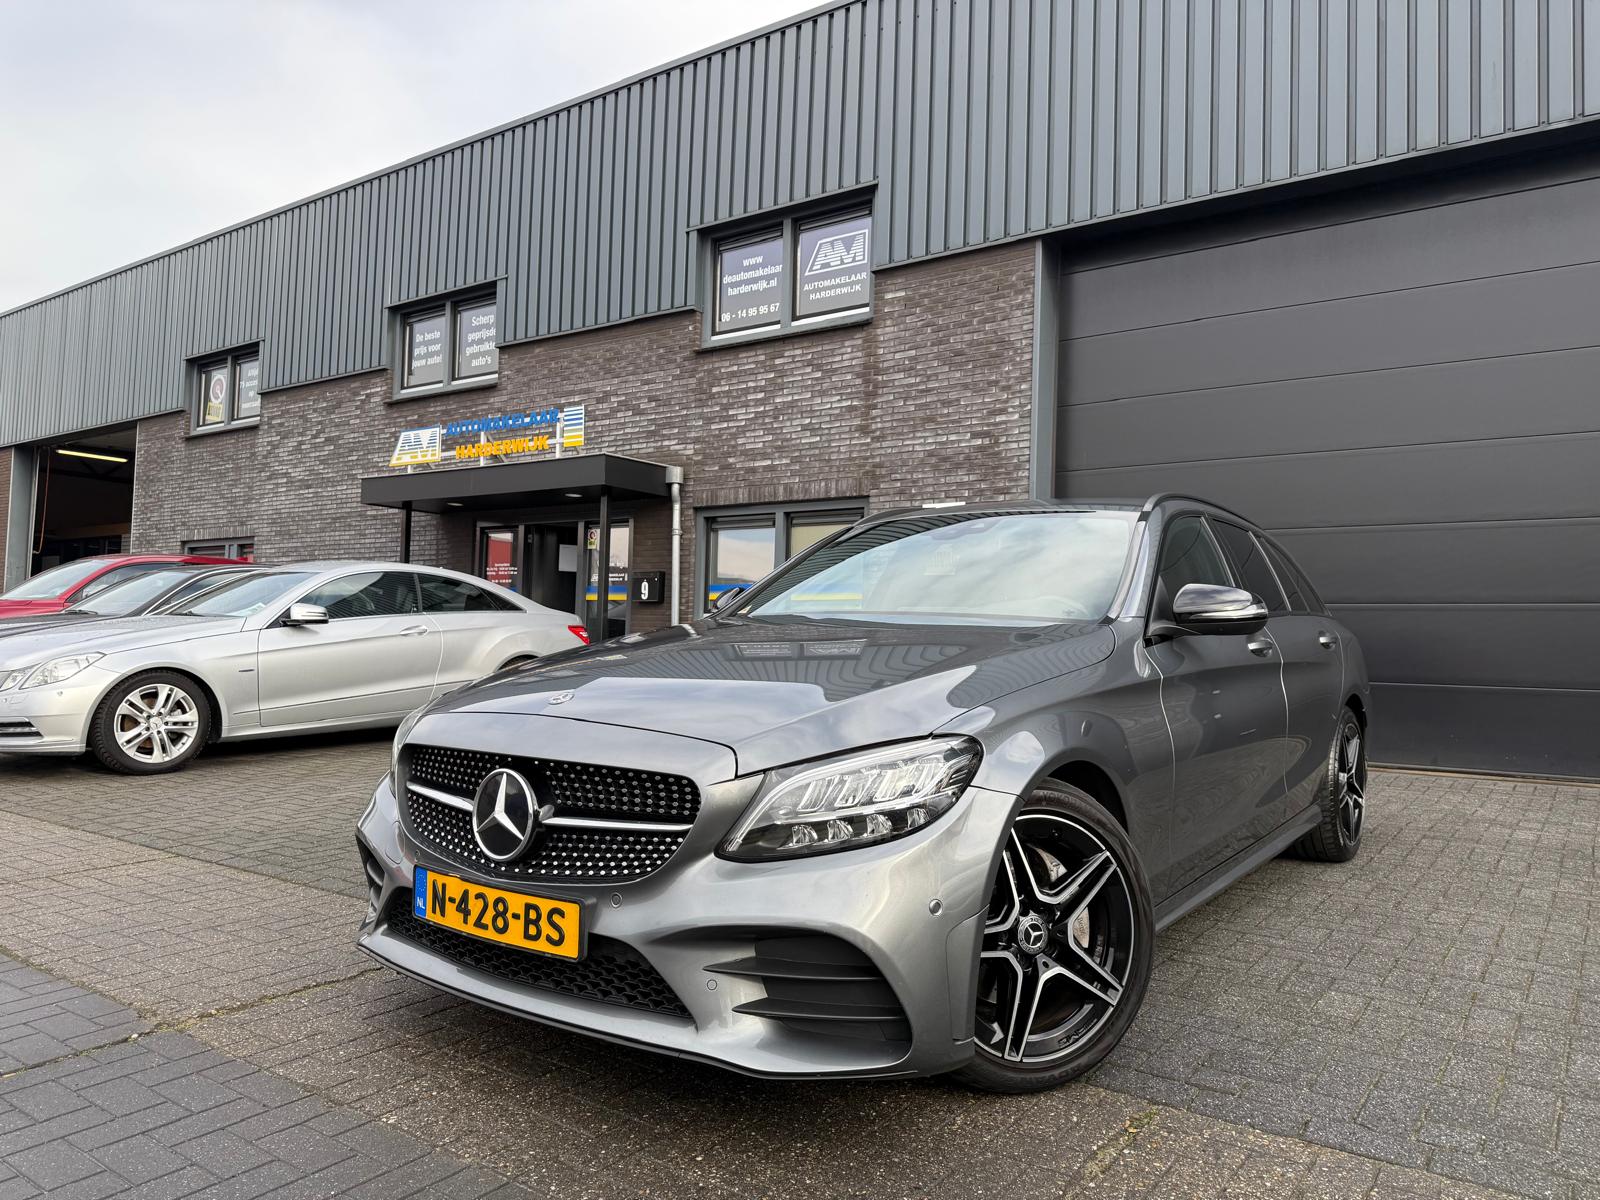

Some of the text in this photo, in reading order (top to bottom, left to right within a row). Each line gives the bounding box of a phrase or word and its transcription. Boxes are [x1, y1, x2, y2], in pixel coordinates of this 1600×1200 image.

[742, 255, 764, 267] www
[723, 265, 783, 284] deautomakelaar
[803, 272, 868, 291] AUTOMAKELAAR
[727, 278, 777, 296] harderwijk.nl
[809, 284, 862, 300] HARDERWIJK
[737, 309, 746, 318] 14
[748, 307, 757, 317] 95
[759, 305, 768, 314] 95
[471, 315, 494, 326] Scherp
[415, 330, 441, 342] De beste
[414, 343, 442, 357] prijs voor
[471, 355, 492, 366] auto's
[444, 408, 560, 437] AUTOMAKELAAR
[455, 434, 550, 460] HARDERWIJK
[640, 581, 649, 600] 9
[416, 897, 425, 909] NL
[431, 879, 566, 947] N-428-BS
